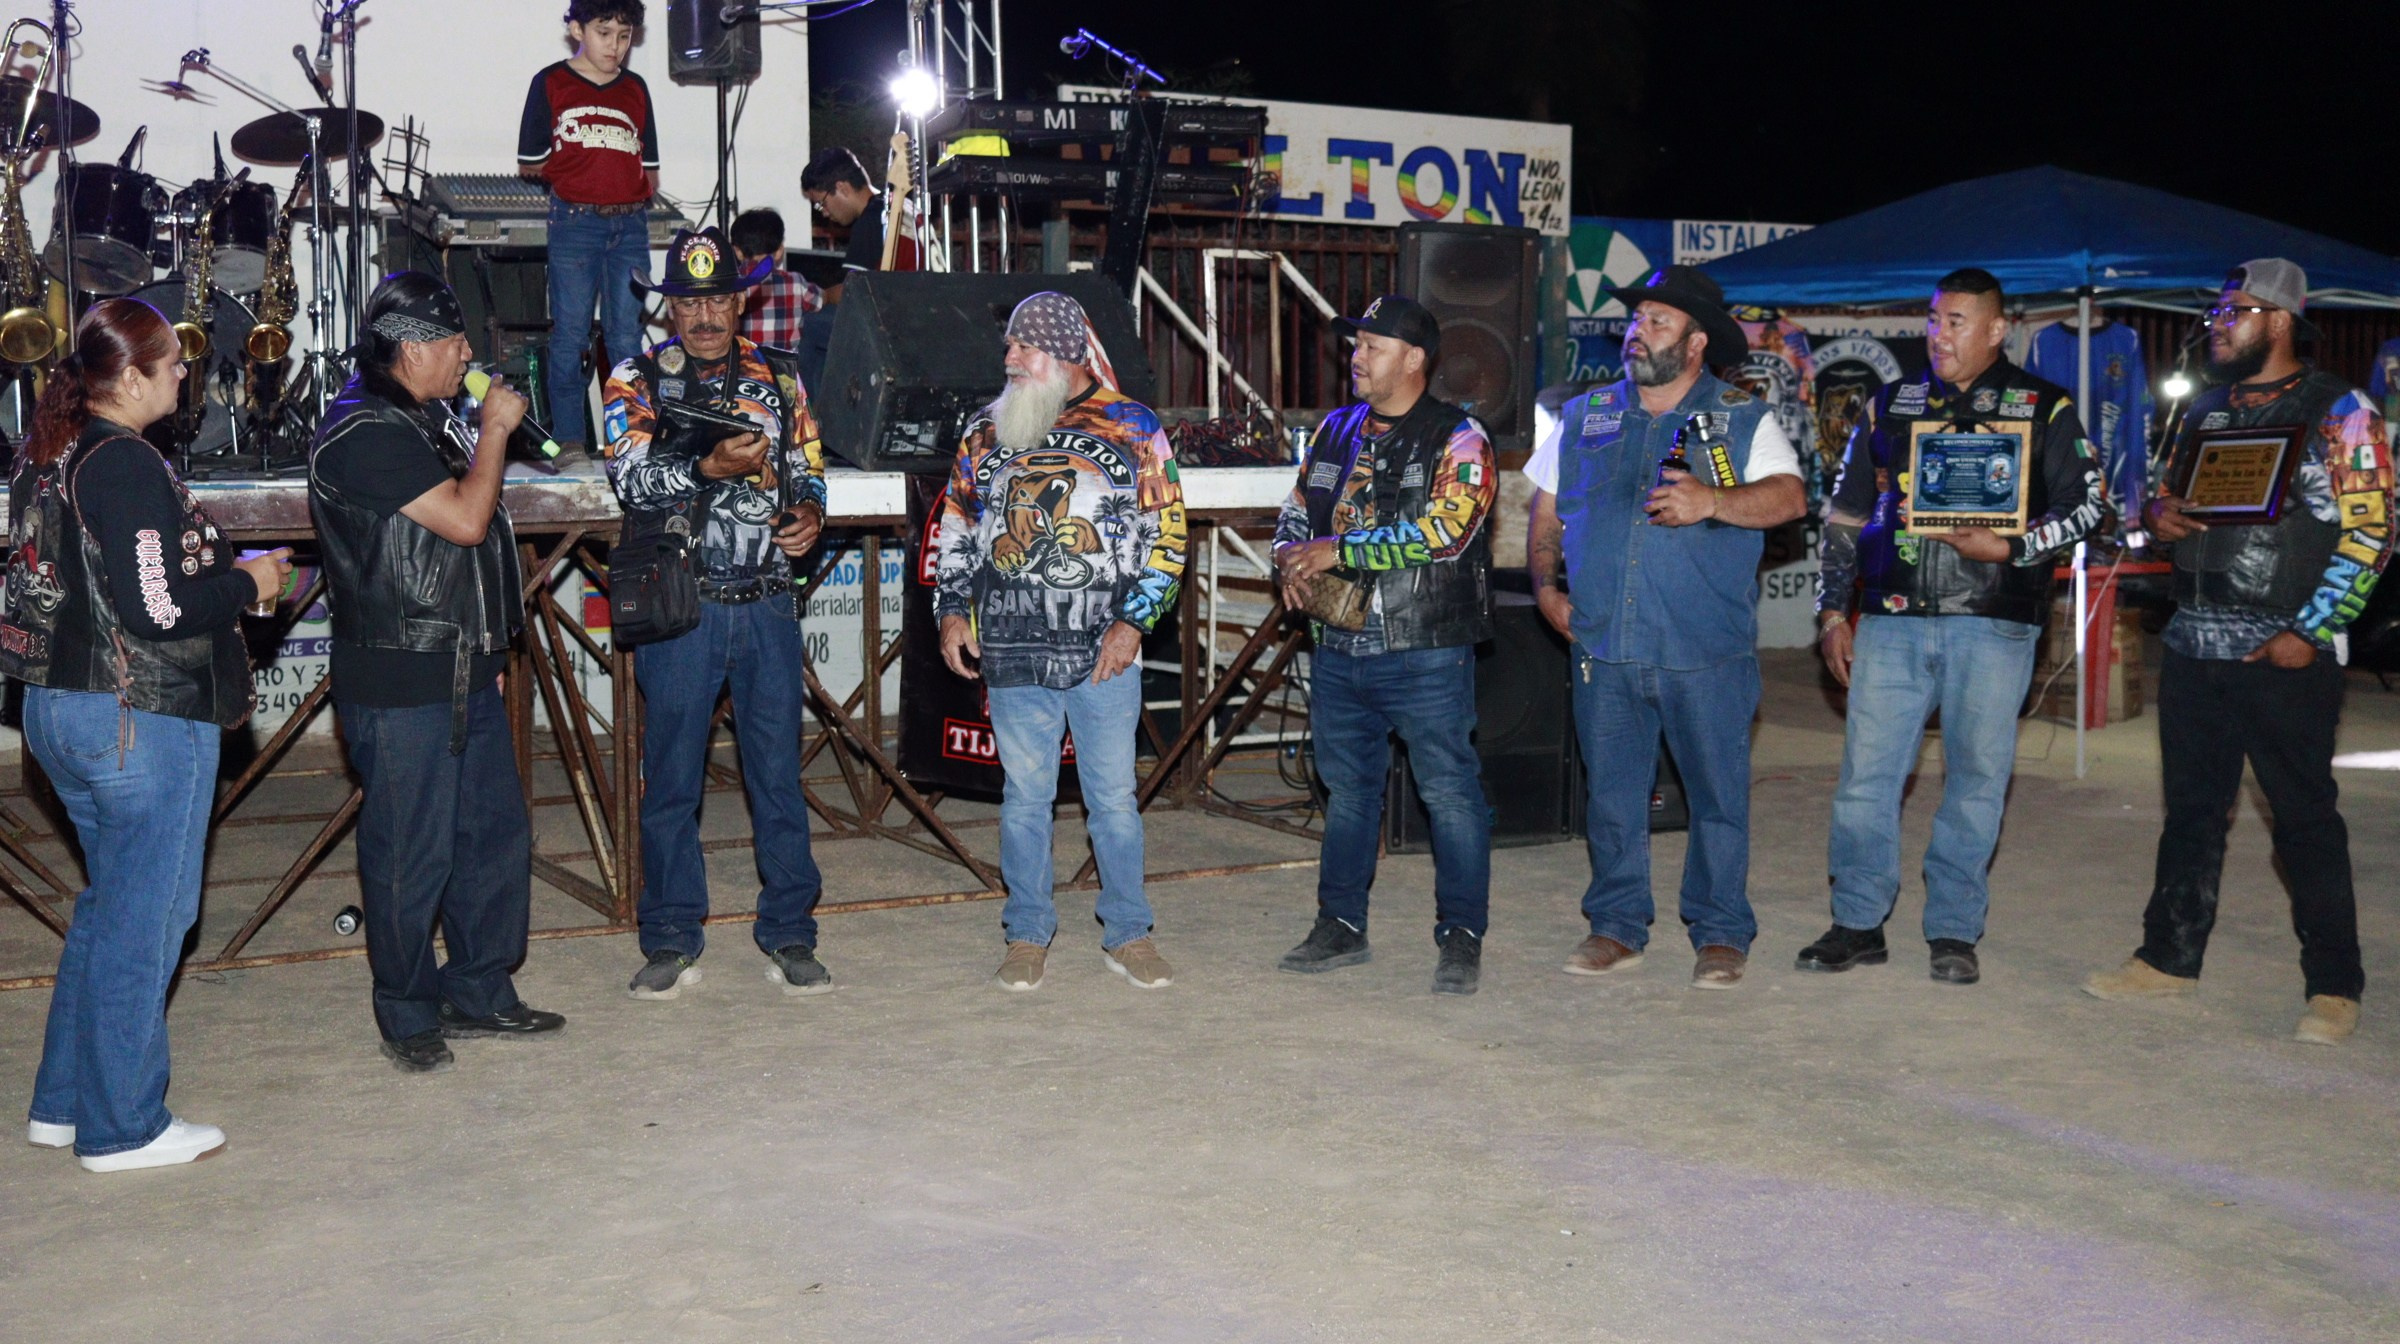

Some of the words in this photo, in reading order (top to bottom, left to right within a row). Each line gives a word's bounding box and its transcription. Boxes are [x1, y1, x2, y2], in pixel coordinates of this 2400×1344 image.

[1044, 108, 1076, 130] M1
[1262, 134, 1525, 228] LTON
[680, 236, 700, 262] PEACE
[701, 236, 721, 262] RIDER
[1047, 433, 1128, 478] VIEJOS
[1343, 542, 1433, 571] LUIS
[986, 589, 1041, 616] SAN
